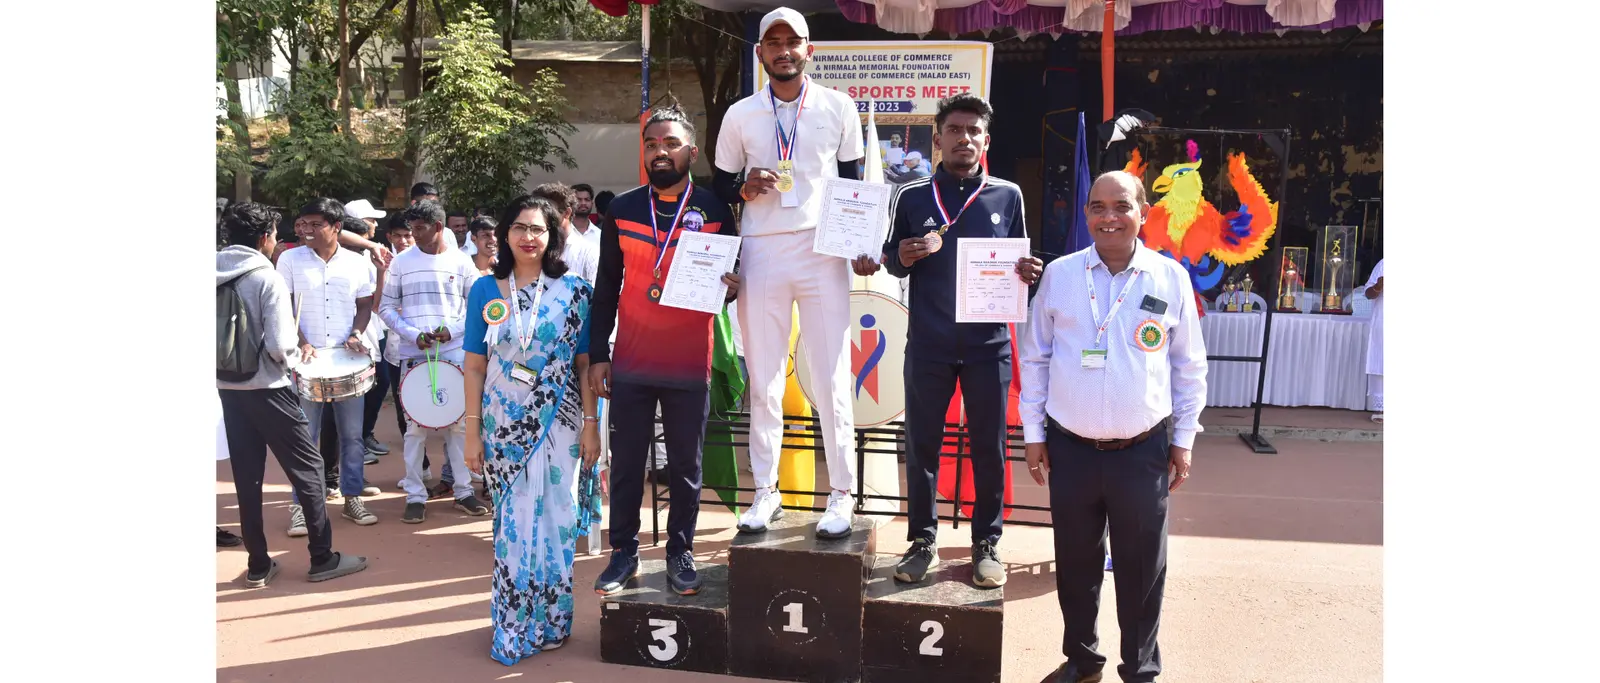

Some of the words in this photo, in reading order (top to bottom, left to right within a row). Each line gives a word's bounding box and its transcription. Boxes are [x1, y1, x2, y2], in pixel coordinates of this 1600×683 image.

[813, 54, 850, 62] NIRMALA
[852, 54, 888, 62] COLLEGE
[890, 54, 901, 62] OF
[917, 72, 947, 80] (MALAD
[949, 72, 971, 80] EAST)
[848, 85, 916, 99] SPORTS
[922, 85, 970, 98] MEET
[855, 102, 899, 111] 22-2023
[782, 602, 809, 634] 1
[647, 618, 679, 662] 3
[918, 619, 945, 657] 2
